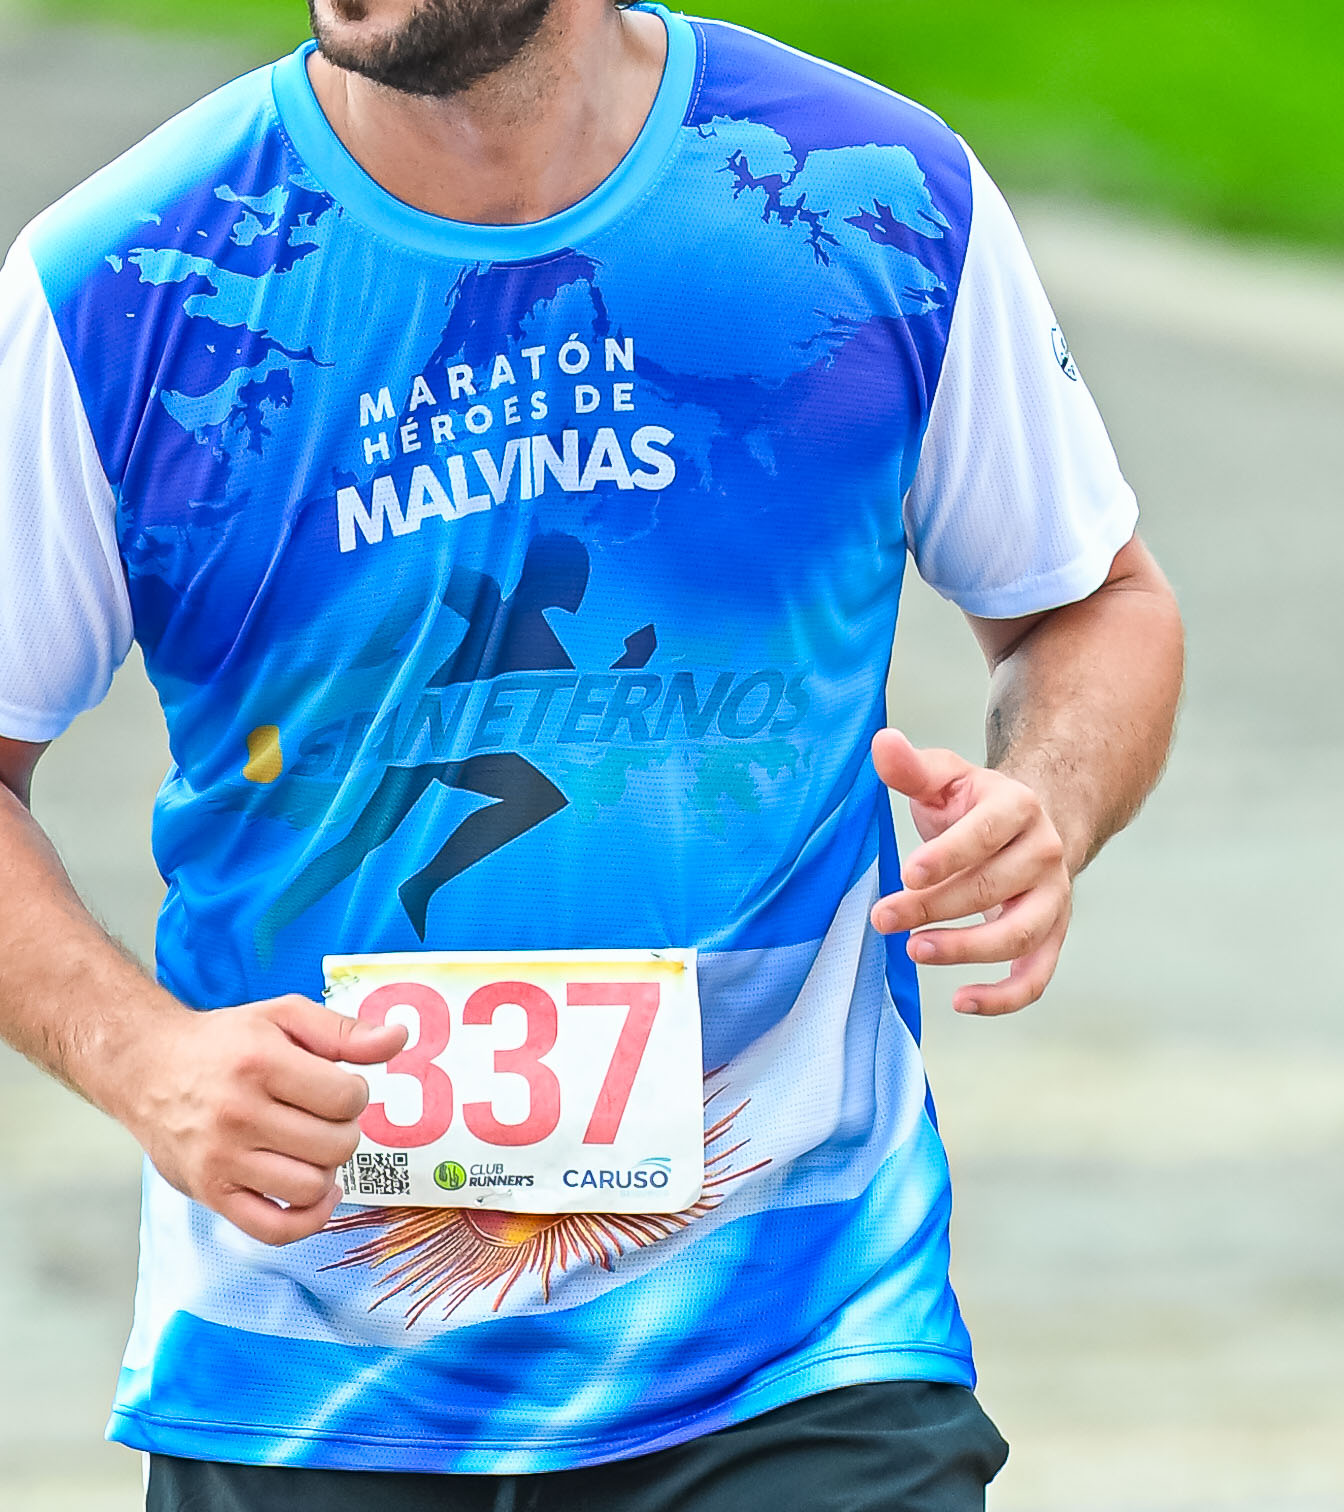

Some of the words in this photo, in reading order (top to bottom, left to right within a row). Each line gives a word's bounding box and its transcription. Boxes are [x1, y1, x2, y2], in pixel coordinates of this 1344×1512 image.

[359, 332, 635, 427] MARATÓN
[362, 390, 549, 465] HÉROES
[574, 382, 635, 414] DE
[336, 425, 676, 553] MALVINAS
[467, 671, 811, 750] ETERNOS
[358, 981, 661, 1149] 337
[469, 1174, 535, 1188] RUNNER'S
[470, 1163, 504, 1176] CLUB
[562, 1169, 669, 1189] CARUSO
